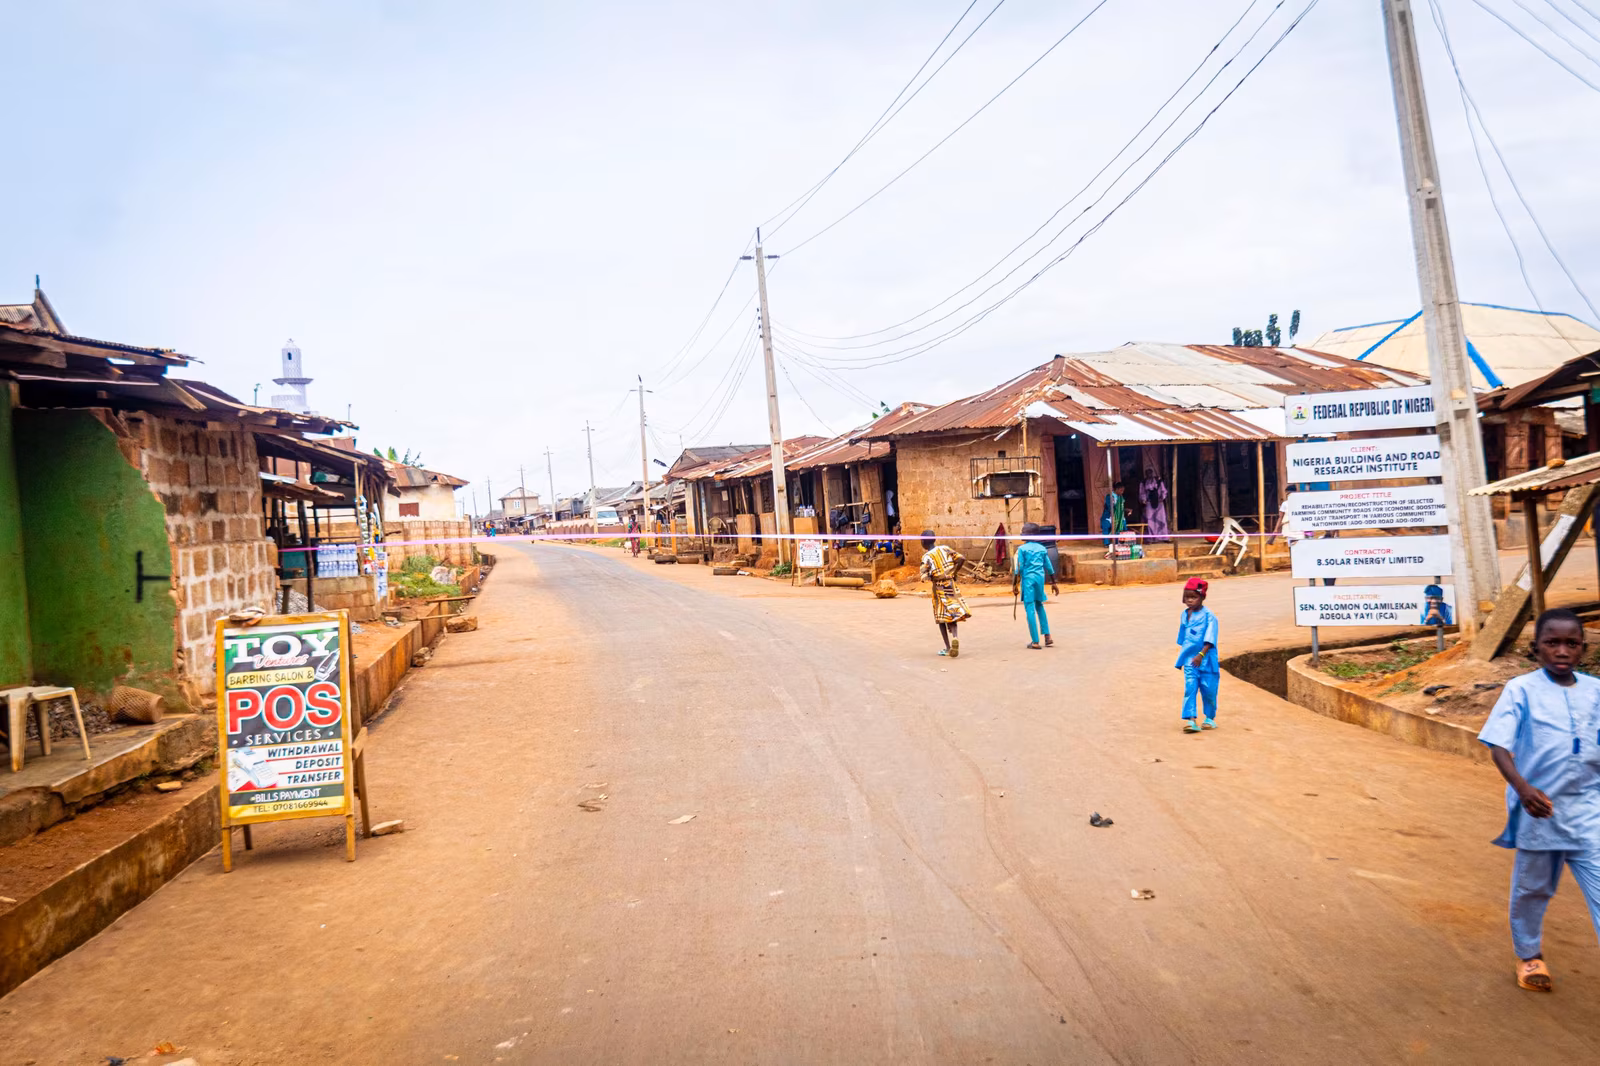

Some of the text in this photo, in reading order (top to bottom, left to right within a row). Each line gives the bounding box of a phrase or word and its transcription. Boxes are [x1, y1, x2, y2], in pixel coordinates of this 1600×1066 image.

[1313, 397, 1434, 420] FEDERAL REPUBLIC OF NIGERI
[1293, 450, 1440, 466] NIGERIA BUILDING AND ROAD
[1314, 462, 1418, 476] RESEARCH INSTITUTE
[1301, 500, 1398, 509] REHABILITATION/RECONSTRUCTION
[1317, 556, 1424, 566] B.SOLAR ENERGY LIMITED
[1320, 603, 1360, 611] SOLOMON
[1364, 602, 1418, 610] OLAMILEKAN
[1376, 612, 1398, 620] (FCA)
[224, 630, 338, 663] TOY
[230, 670, 314, 686] BARBING SALON &
[226, 681, 342, 734] POS
[246, 728, 322, 746] SERVICES
[268, 742, 340, 758] WITHDRAWAL
[296, 757, 341, 770] DEPOSIT
[288, 772, 341, 784] TRANSFER
[255, 788, 321, 802] BILLS PAYMENT
[254, 805, 270, 813] TEL:
